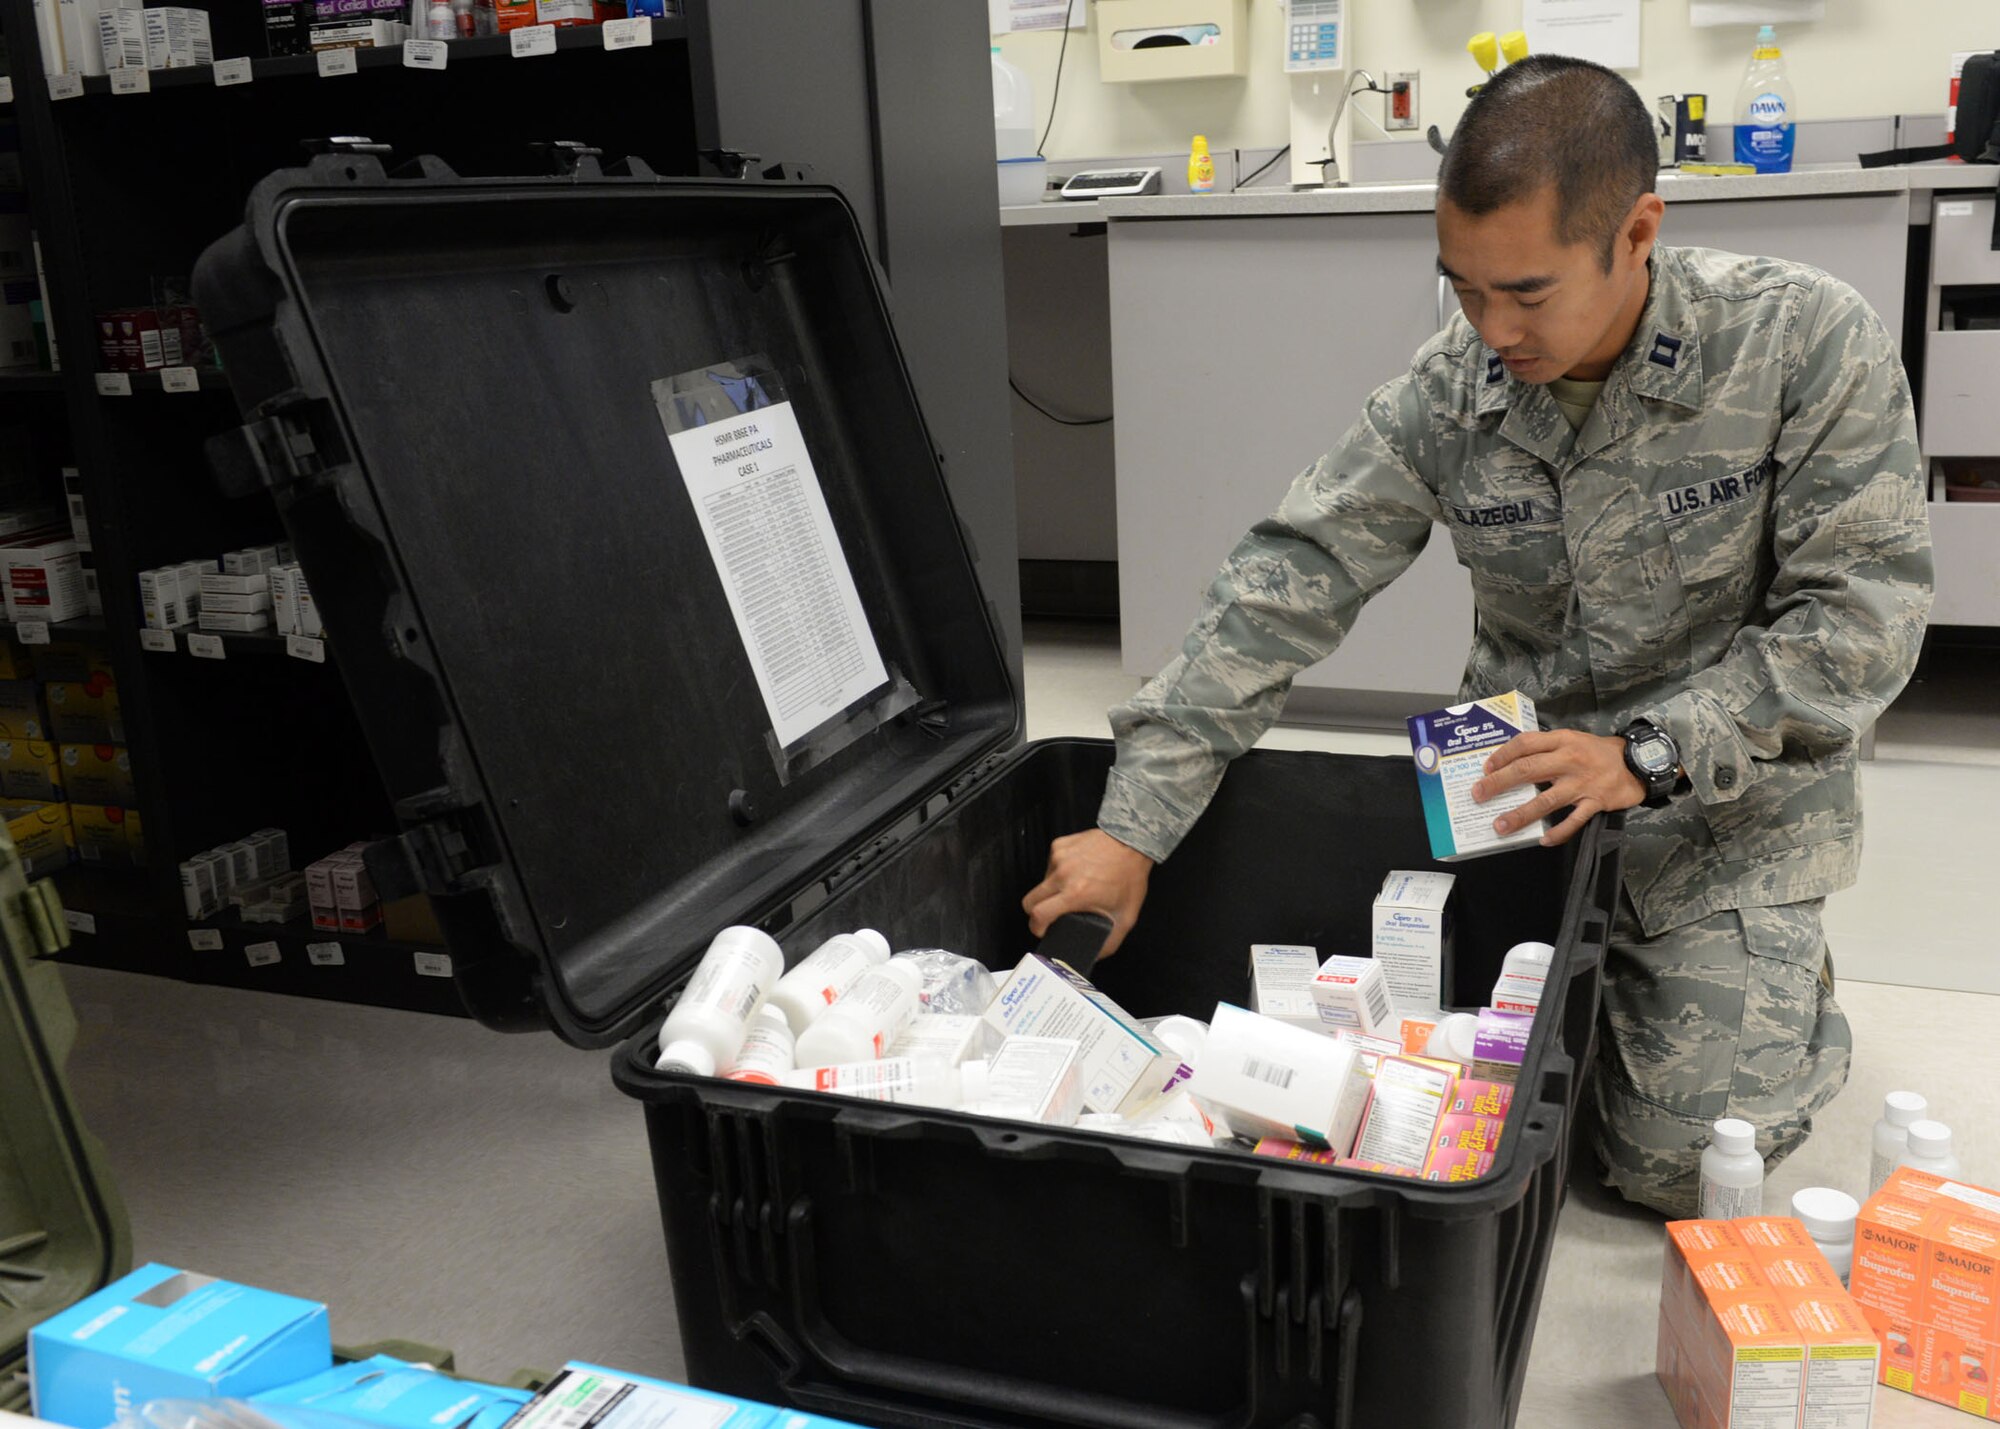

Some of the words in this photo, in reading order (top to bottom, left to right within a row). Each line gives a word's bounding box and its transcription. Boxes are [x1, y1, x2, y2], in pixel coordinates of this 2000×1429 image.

[1750, 103, 1786, 114] DAWN
[712, 438, 773, 467] PHARMACEUTICALS
[738, 463, 754, 477] CASE
[1666, 487, 1706, 515] U.S.
[1708, 478, 1741, 505] AIR
[1447, 737, 1462, 747] Oral
[1464, 729, 1505, 743] Suspension
[1454, 724, 1479, 737] Cipro
[1482, 721, 1495, 731] 5%
[1472, 1095, 1488, 1115] pain
[1457, 1130, 1474, 1150] pain
[1874, 1233, 1917, 1252] MAJOR
[1859, 1256, 1915, 1280] Ibuprofen
[1866, 1250, 1911, 1269] Children's
[1947, 1255, 1992, 1275] MAJOR
[1932, 1278, 1990, 1304] Ibuprofen
[1939, 1272, 1984, 1292] Children's
[1920, 1328, 1936, 1384] Children's
